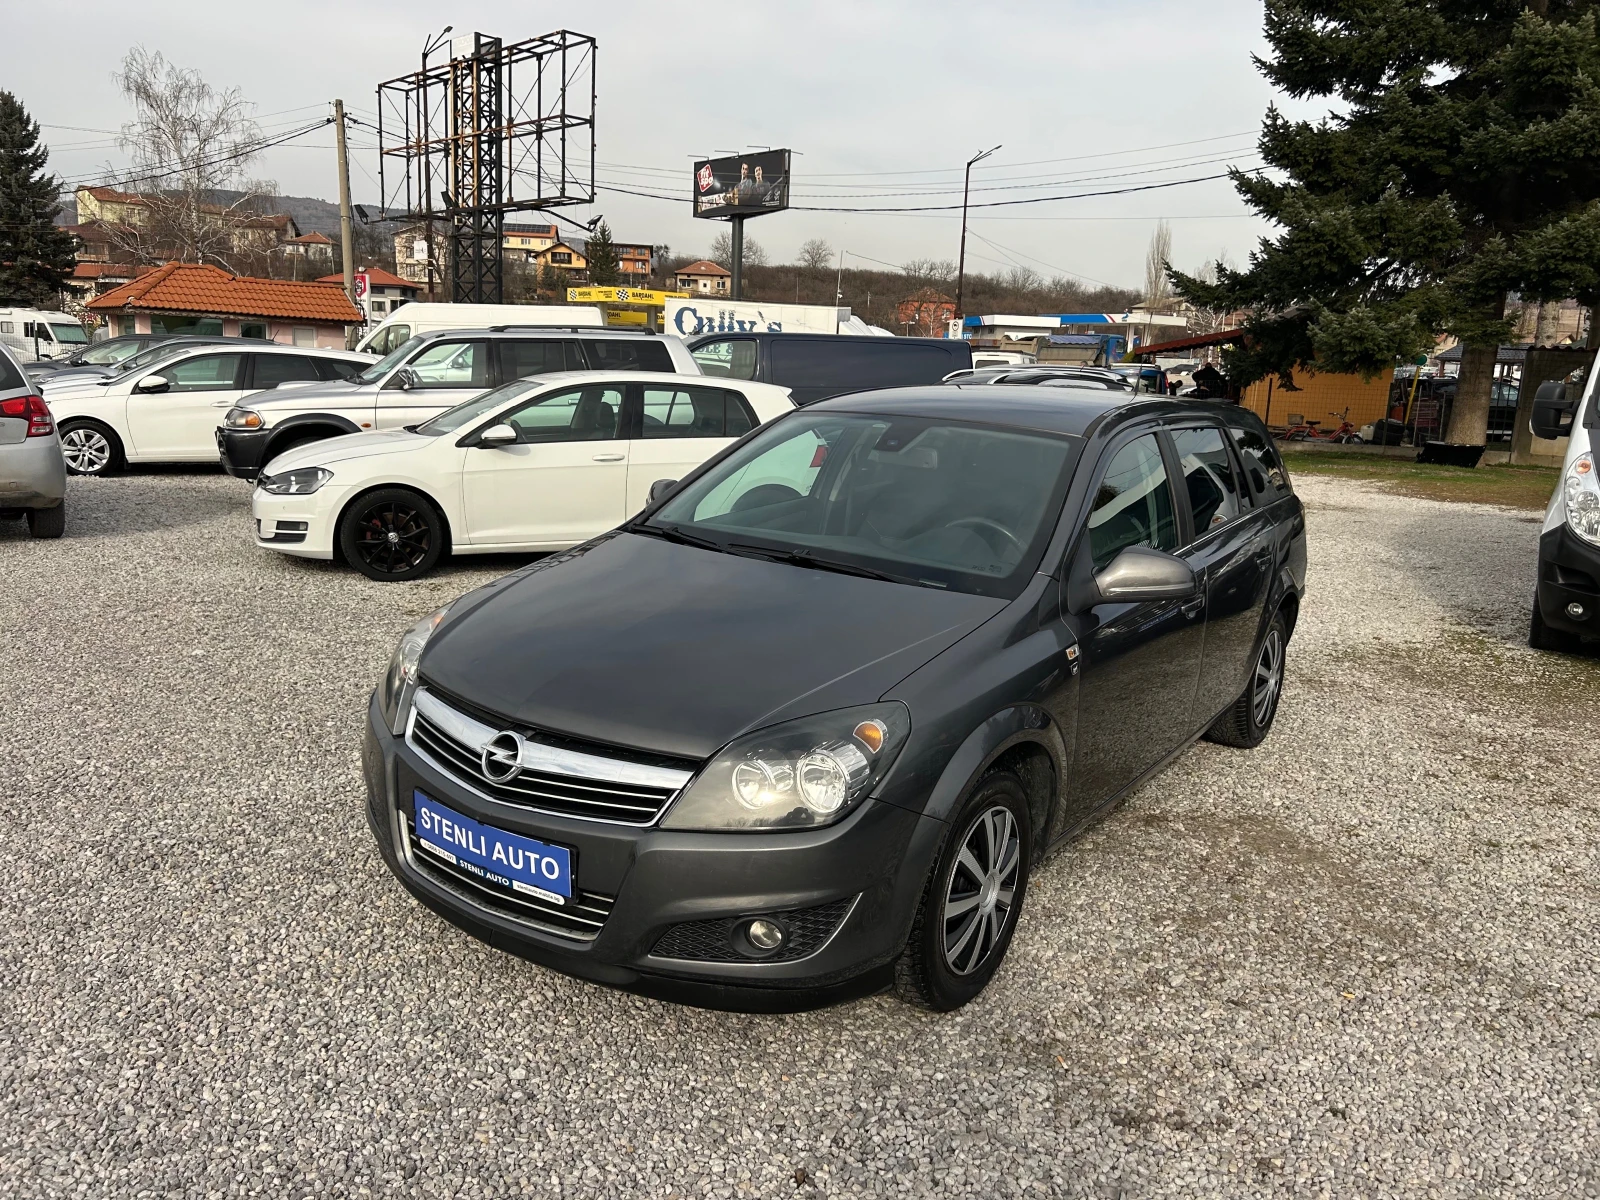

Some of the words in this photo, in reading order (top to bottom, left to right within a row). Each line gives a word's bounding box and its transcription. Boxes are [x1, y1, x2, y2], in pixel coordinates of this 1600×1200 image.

[700, 167, 709, 178] fit
[700, 176, 714, 187] spo
[632, 292, 654, 300] BARDAHL
[420, 807, 486, 857] STENLI
[491, 842, 560, 880] AUTO
[459, 859, 484, 877] STENLI
[486, 871, 510, 886] AUTO
